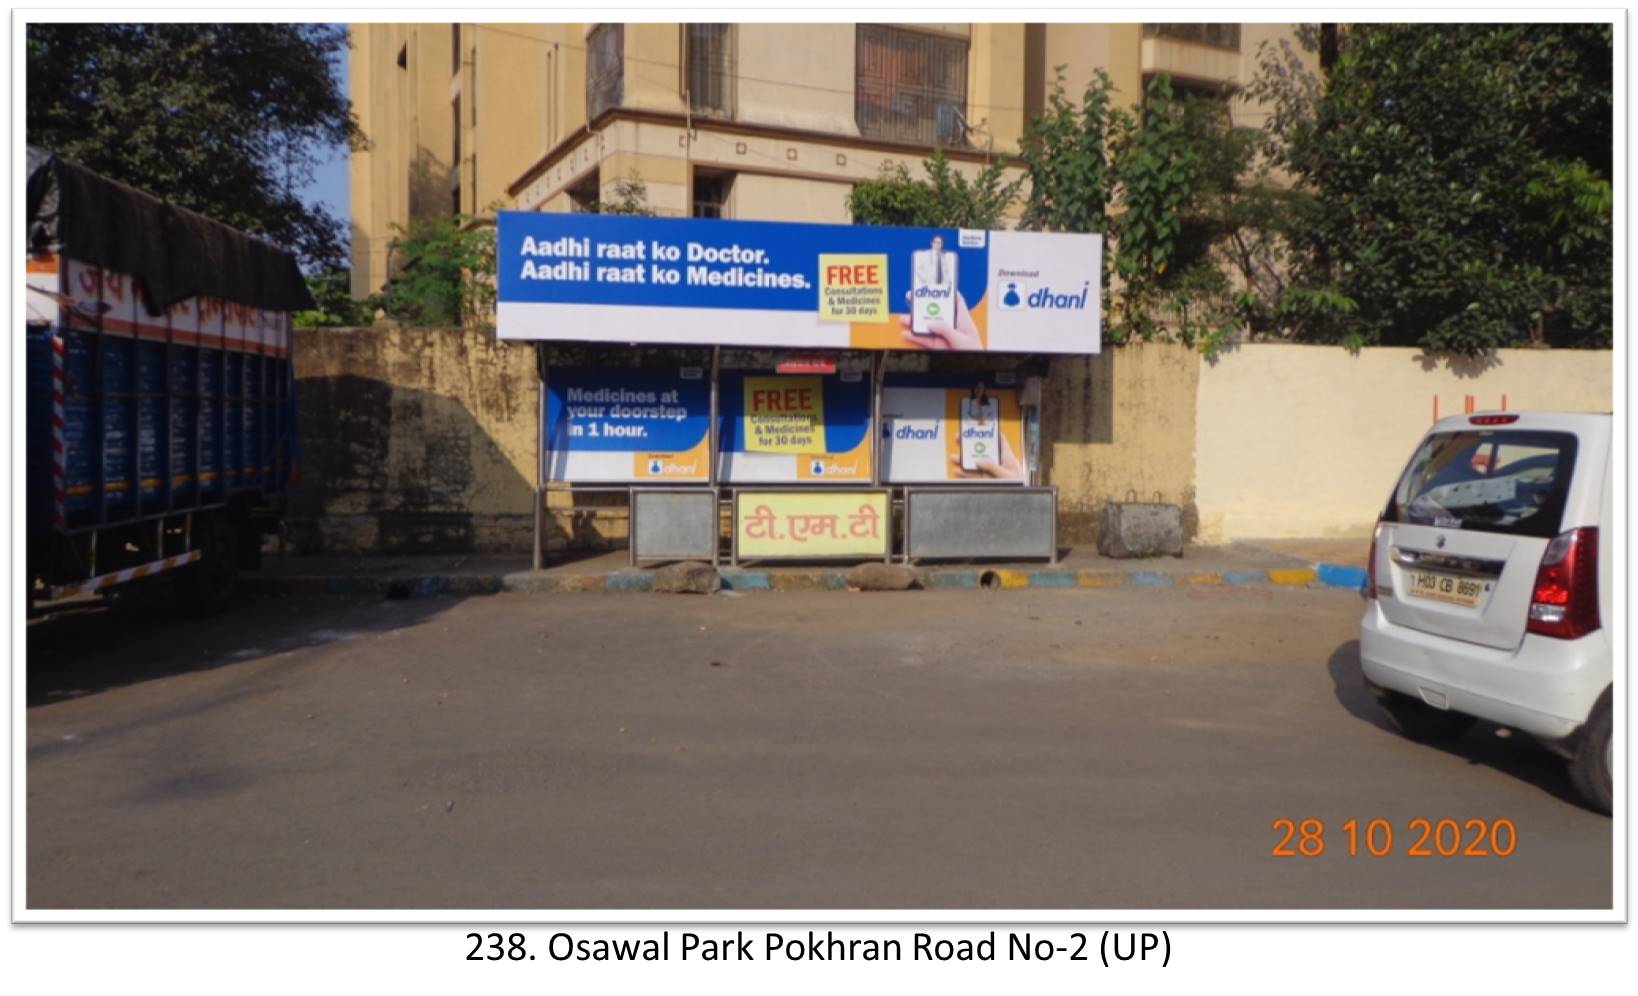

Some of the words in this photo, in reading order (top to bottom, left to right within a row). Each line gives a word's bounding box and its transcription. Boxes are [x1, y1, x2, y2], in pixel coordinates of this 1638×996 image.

[520, 235, 590, 258] Aadhi
[597, 240, 645, 260] raat
[651, 241, 680, 261] ko
[687, 242, 769, 264] Doctor.
[520, 260, 590, 281] Aadhi
[597, 263, 645, 283] raat
[651, 265, 680, 285] ko
[687, 266, 811, 289] Medicines.
[826, 265, 879, 285] FREE
[824, 286, 883, 296] Consultations
[915, 281, 952, 298] dhani
[1027, 281, 1089, 309] dhani
[828, 297, 836, 305] &
[837, 296, 880, 305] Medicines
[831, 306, 843, 315] for
[845, 306, 856, 315] 30
[858, 306, 877, 316] days
[566, 388, 656, 403] Medicines
[661, 390, 679, 404] at
[752, 388, 813, 412] FREE
[566, 405, 605, 420] your
[610, 405, 687, 422] doorstep
[568, 422, 583, 437] in
[588, 422, 599, 437] 1
[603, 422, 648, 438] hour.
[896, 420, 939, 440] dhani
[963, 425, 994, 440] dhani
[758, 436, 772, 446] for
[775, 436, 788, 446] 30
[790, 436, 812, 448] days
[744, 504, 880, 542] टी.एम.टी
